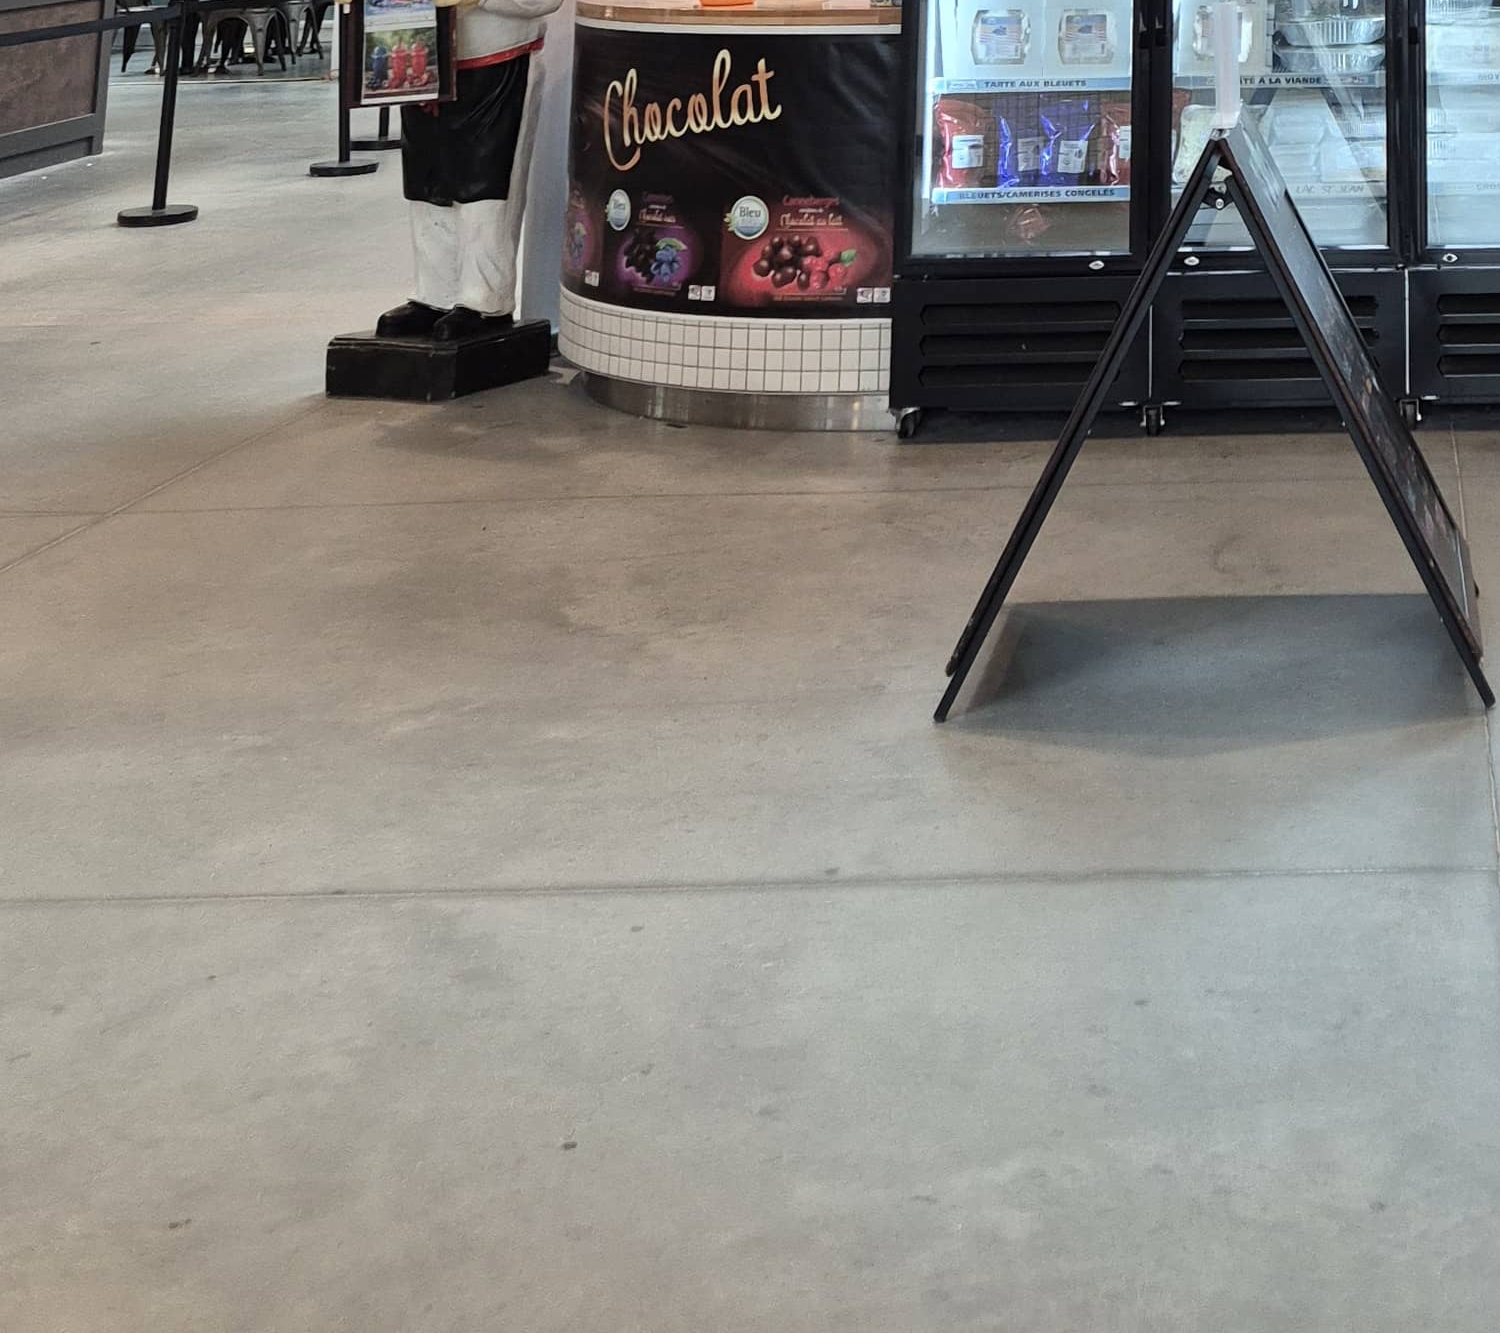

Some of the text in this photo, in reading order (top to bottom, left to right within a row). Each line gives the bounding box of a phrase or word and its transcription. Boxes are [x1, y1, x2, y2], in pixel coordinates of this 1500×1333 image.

[1285, 76, 1322, 84] VIANDE
[604, 49, 782, 171] Chocolat
[739, 206, 761, 218] Bleu
